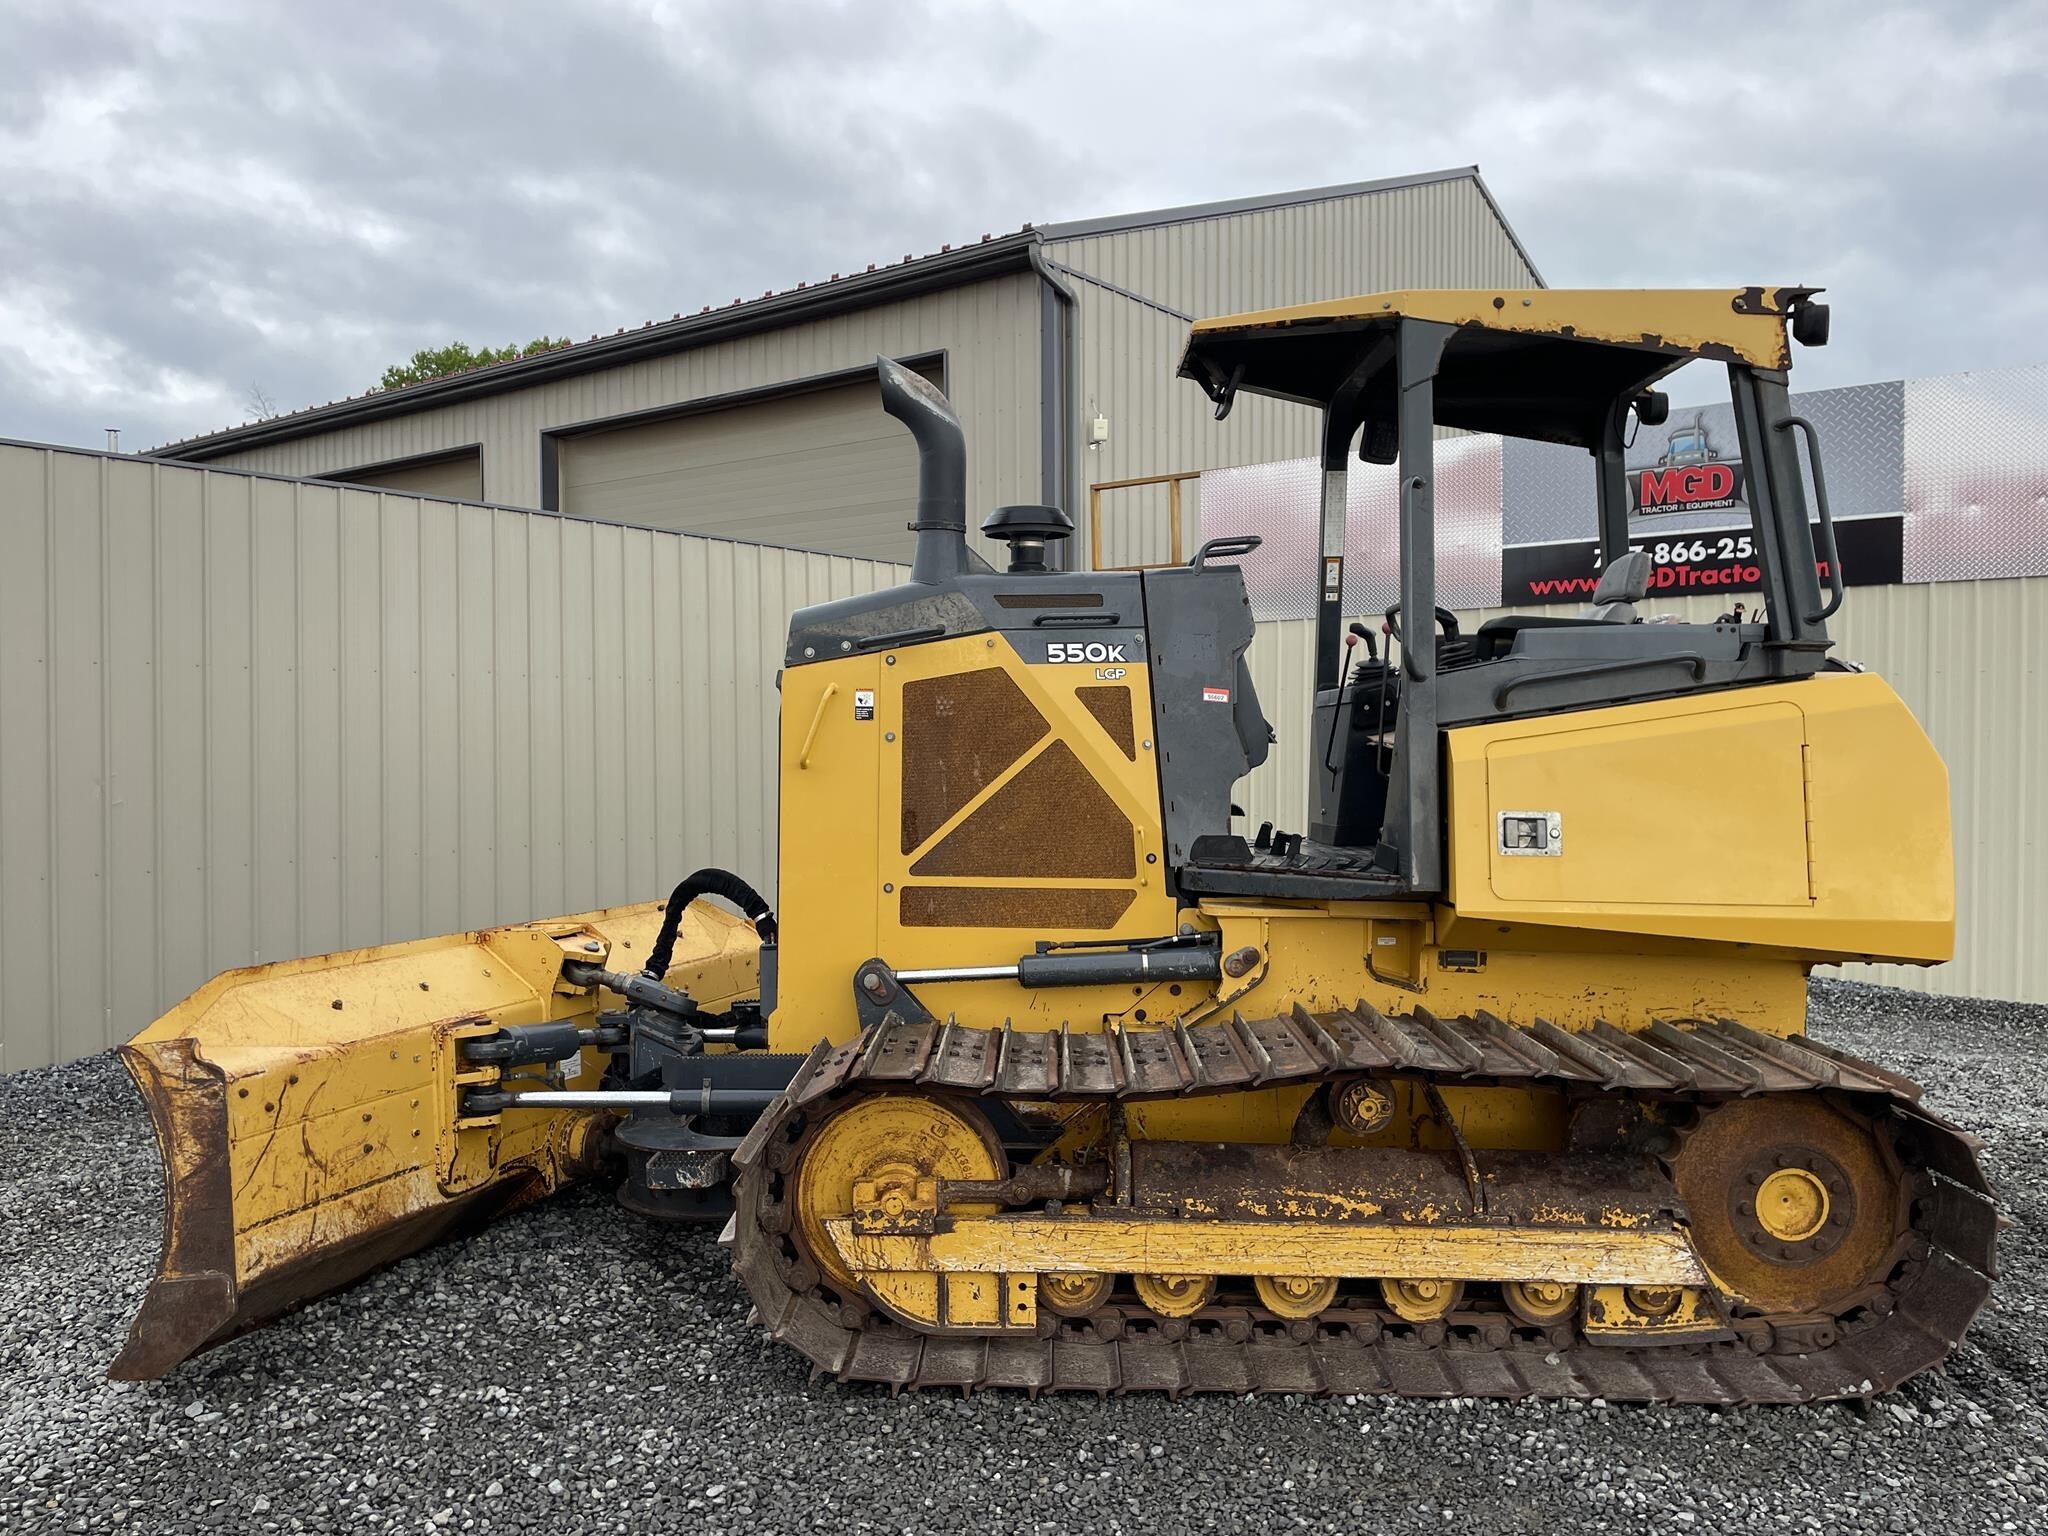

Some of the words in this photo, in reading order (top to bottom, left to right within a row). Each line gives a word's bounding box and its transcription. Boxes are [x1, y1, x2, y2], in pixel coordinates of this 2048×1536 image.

[1641, 464, 1734, 506] MGD
[1641, 504, 1678, 514] TRACTOR
[1686, 499, 1734, 510] EQUIPMENT
[1046, 642, 1128, 663] 550K
[1096, 668, 1126, 680] LGP
